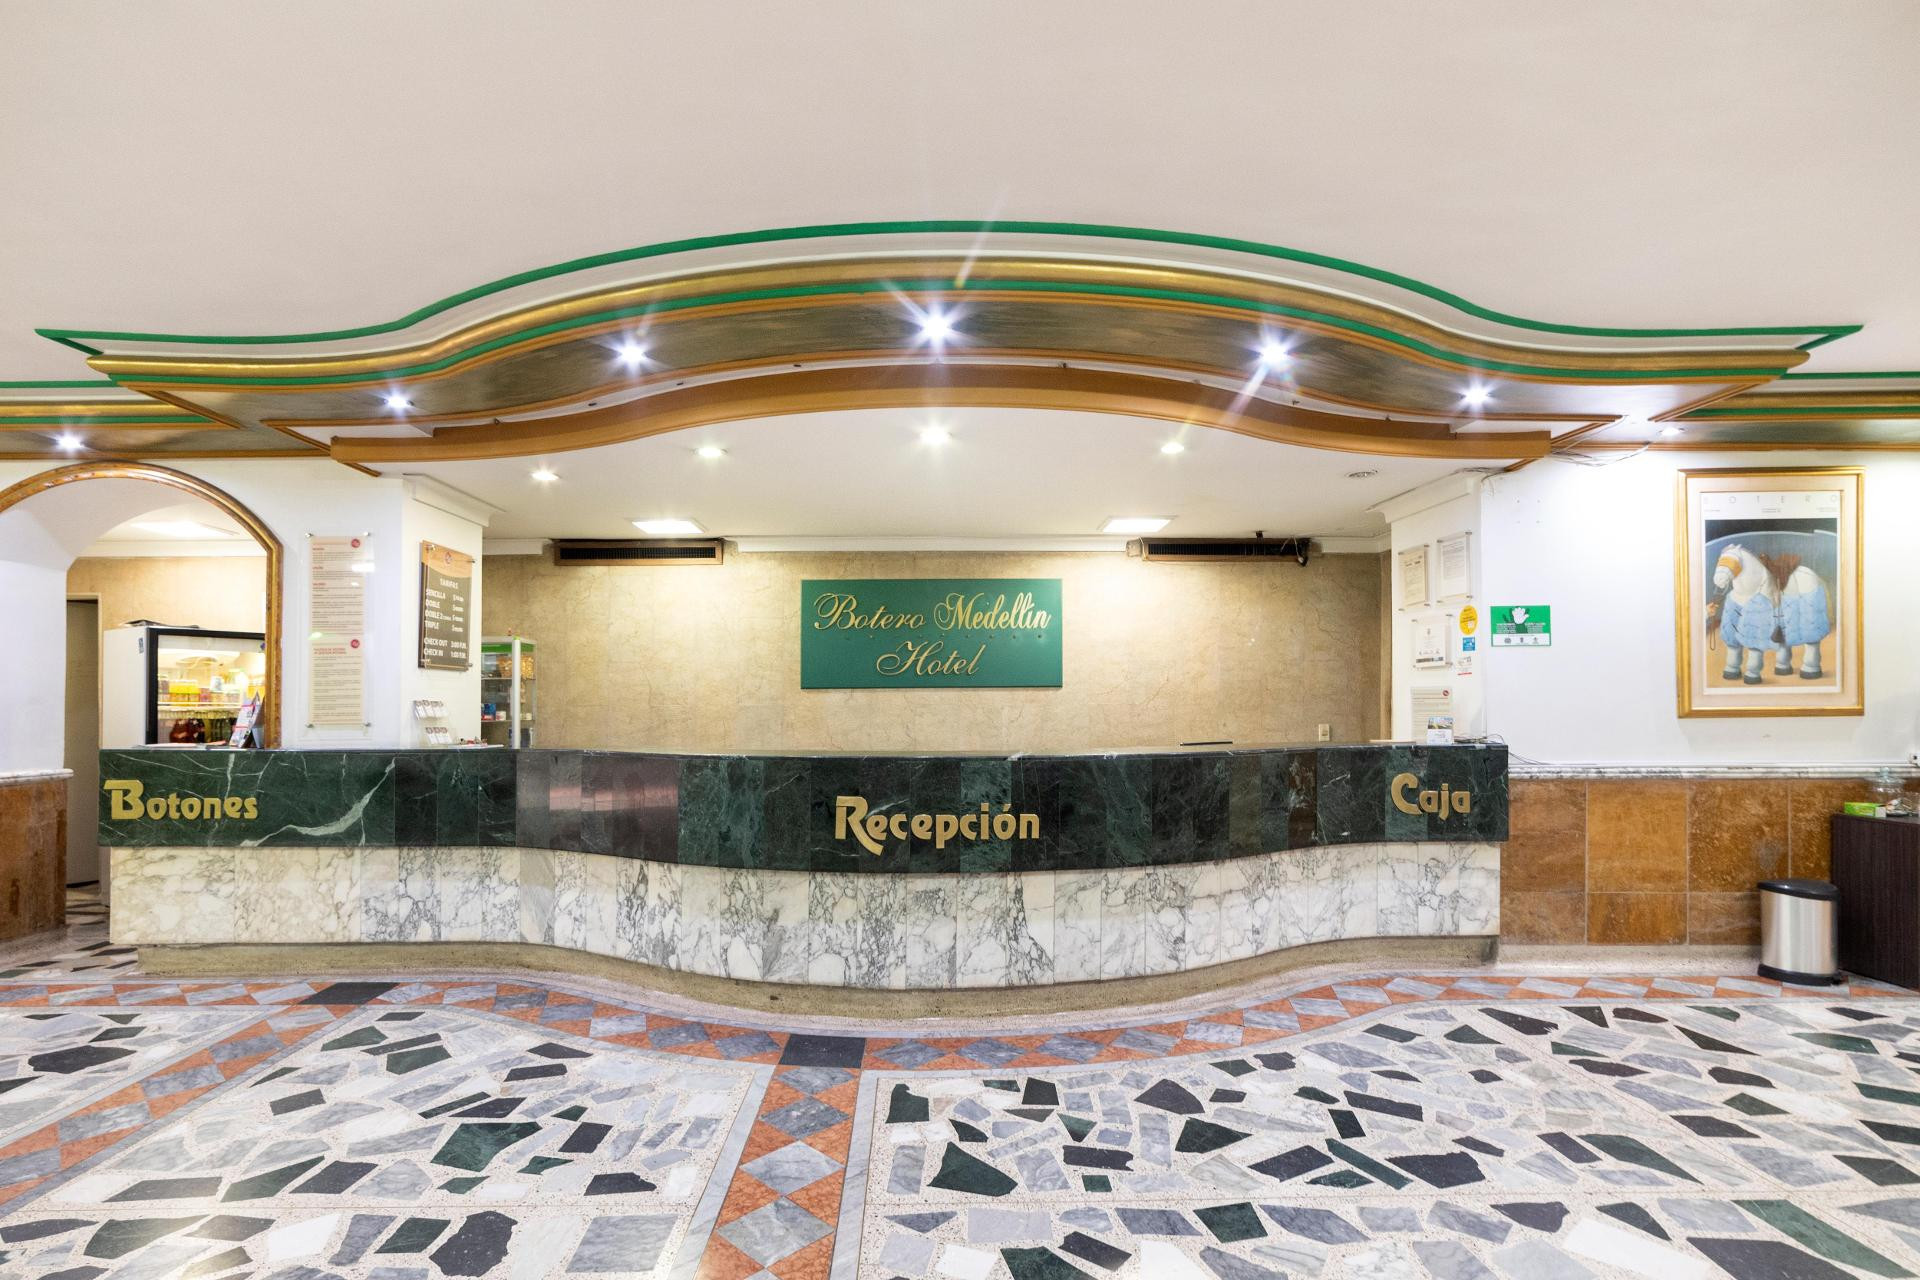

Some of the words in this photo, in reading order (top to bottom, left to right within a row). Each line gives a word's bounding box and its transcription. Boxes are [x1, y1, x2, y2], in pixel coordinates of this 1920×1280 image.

[813, 592, 926, 630] Botero
[933, 591, 1051, 631] Medellín
[876, 640, 987, 676] Hotel
[103, 779, 259, 820] Botones
[1391, 772, 1471, 821] Caja
[834, 795, 1040, 856] Recepción
